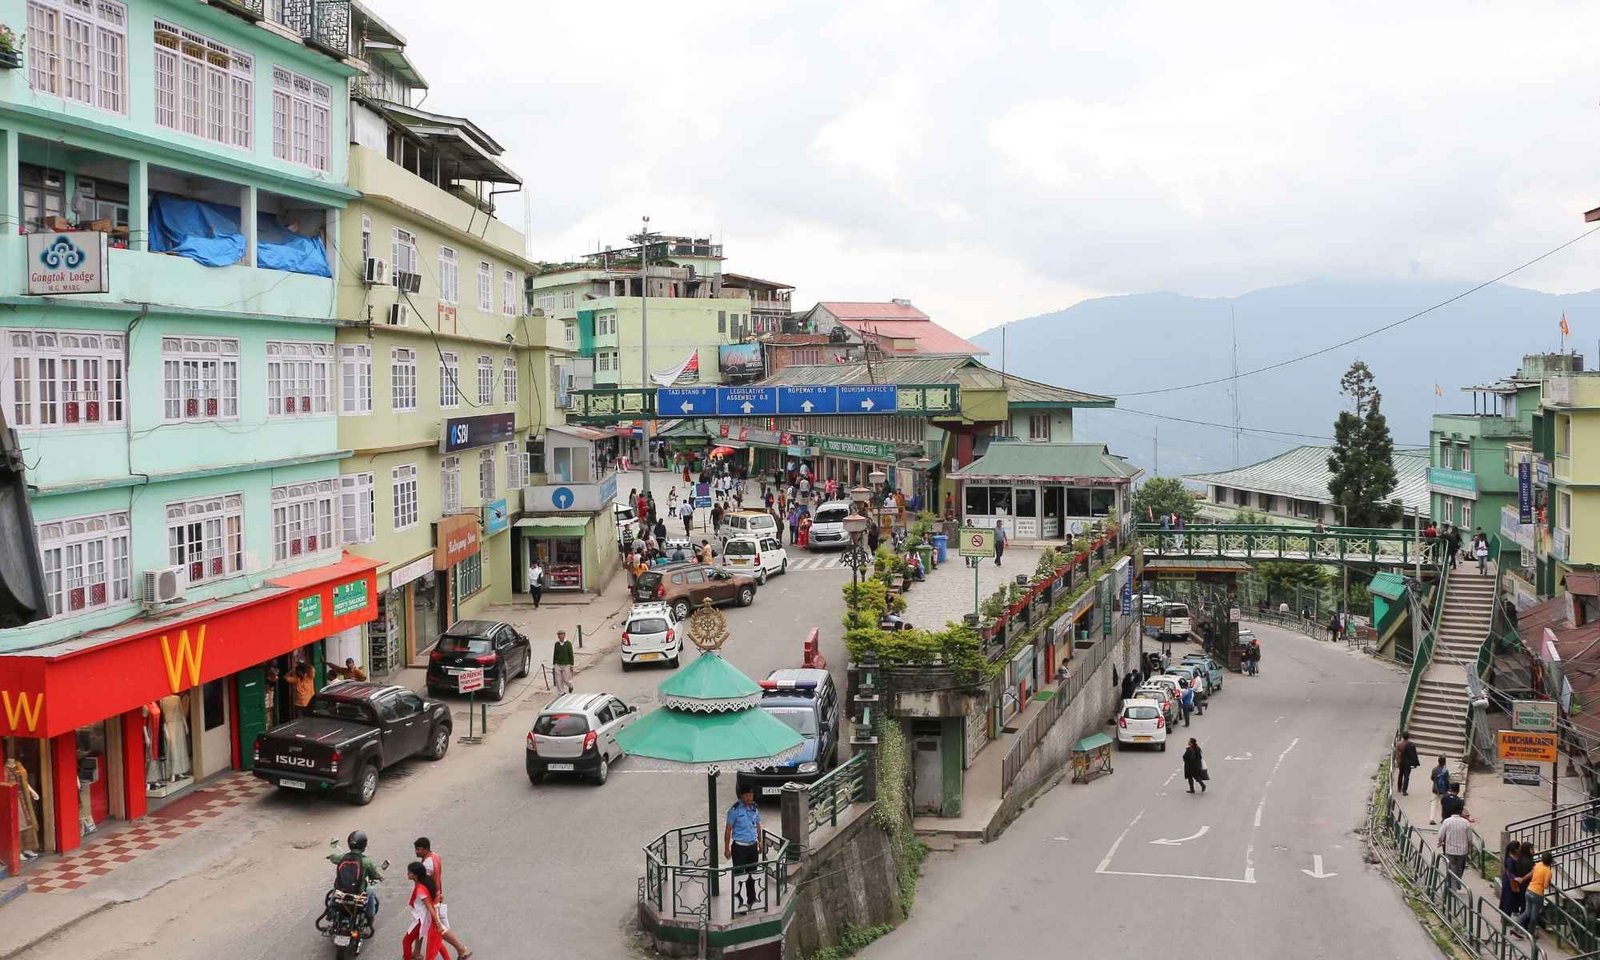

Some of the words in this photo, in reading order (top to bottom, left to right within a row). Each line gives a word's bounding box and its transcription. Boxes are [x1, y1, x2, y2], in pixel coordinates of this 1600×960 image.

[32, 272, 65, 284] Gangtok
[70, 271, 94, 283] Lodge
[457, 424, 469, 444] SBI
[160, 624, 206, 693] W
[2, 691, 43, 732] W
[276, 754, 315, 768] ISUZU
